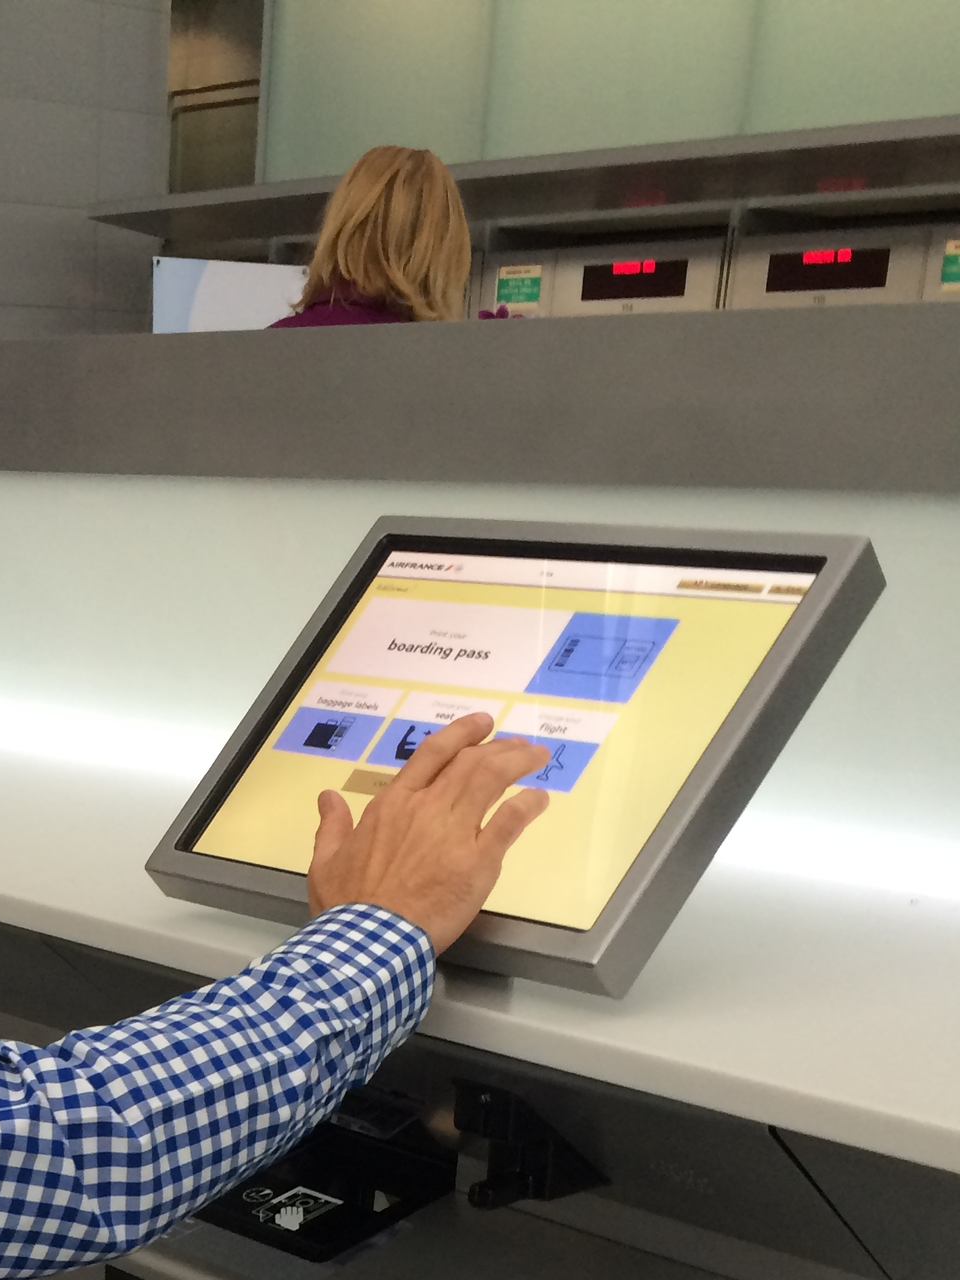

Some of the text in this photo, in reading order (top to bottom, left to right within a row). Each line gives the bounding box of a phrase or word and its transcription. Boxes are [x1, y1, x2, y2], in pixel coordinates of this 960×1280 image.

[387, 638, 491, 661] boarding pass
[317, 696, 379, 711] baggage labels
[435, 711, 455, 720] seat
[539, 722, 568, 734] flight
